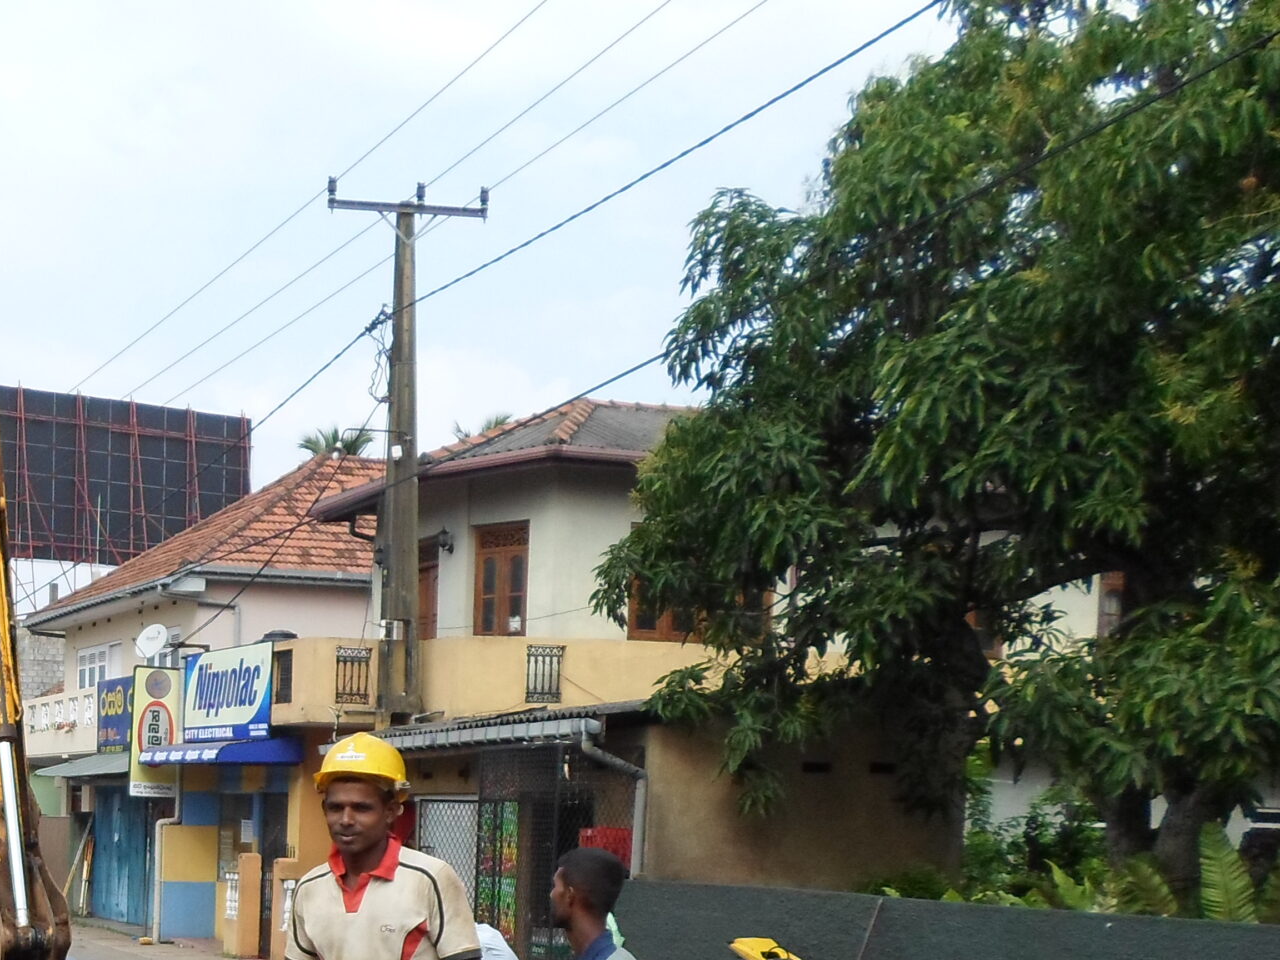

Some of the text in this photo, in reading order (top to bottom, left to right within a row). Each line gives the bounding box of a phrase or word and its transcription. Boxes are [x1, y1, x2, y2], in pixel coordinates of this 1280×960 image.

[193, 658, 261, 718] Nippolac
[184, 727, 234, 739] CITY ELECTRICAL
